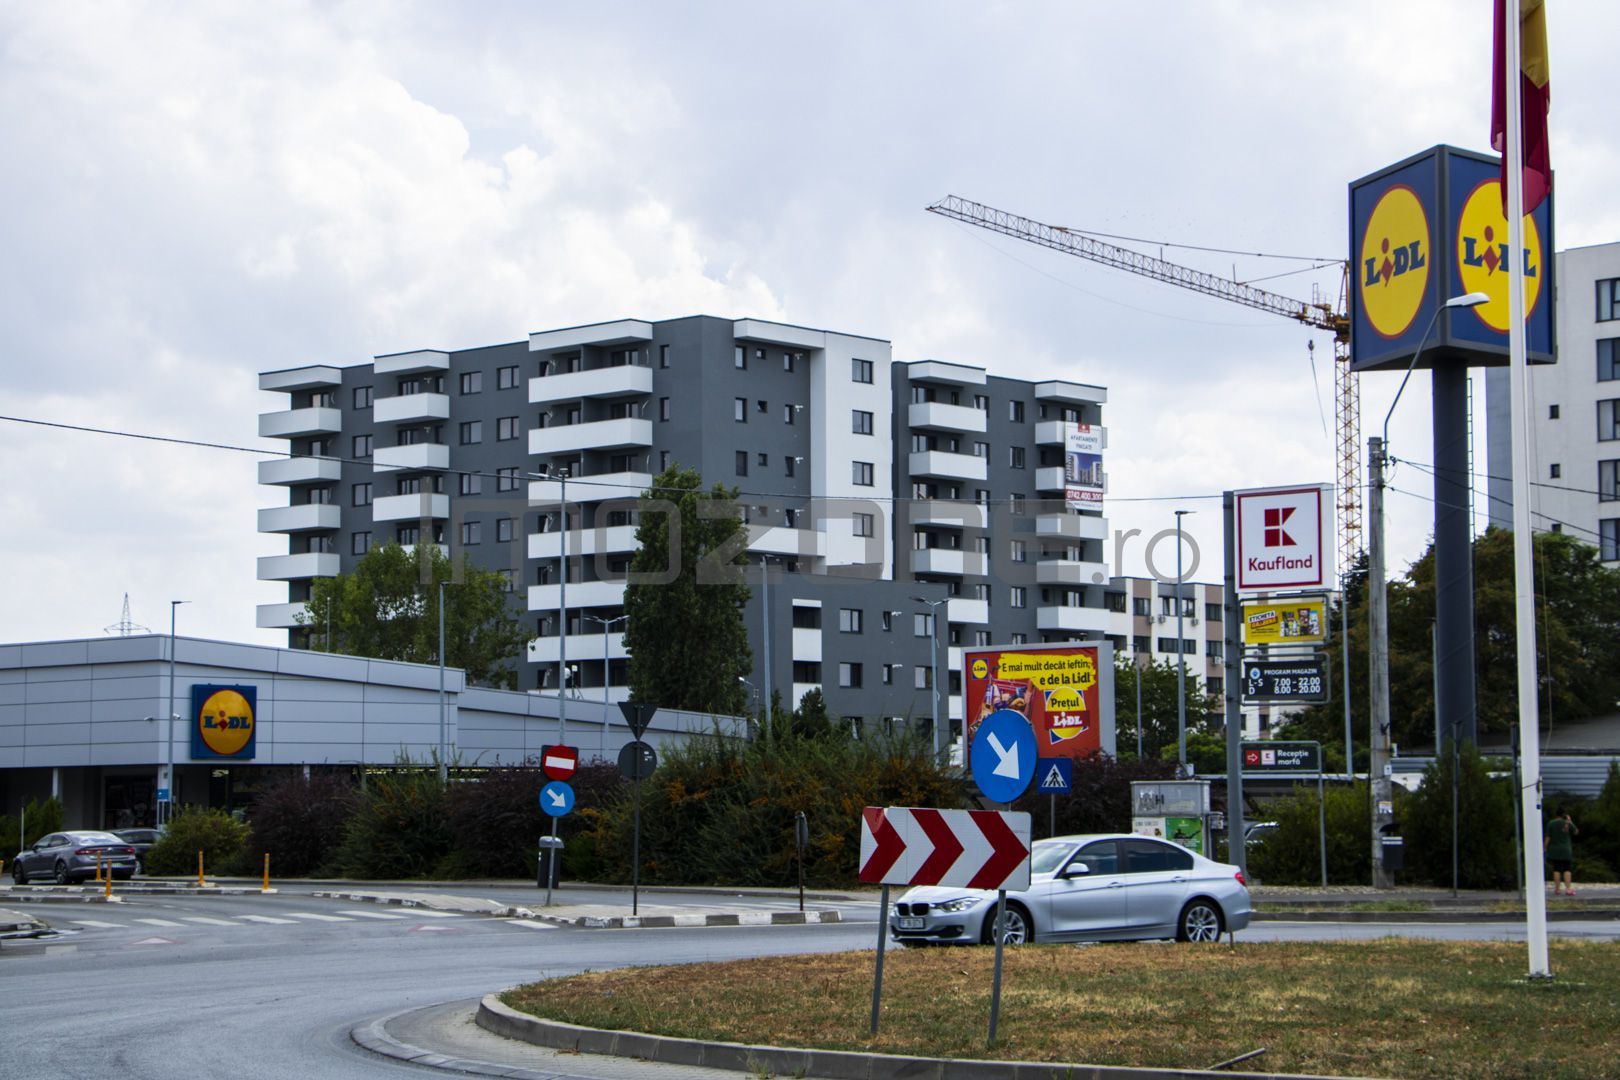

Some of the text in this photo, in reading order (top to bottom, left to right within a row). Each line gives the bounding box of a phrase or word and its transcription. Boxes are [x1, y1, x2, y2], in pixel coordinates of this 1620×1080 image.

[1249, 554, 1313, 571] Kaufland
[1002, 663, 1007, 672] E
[1009, 661, 1022, 671] mai
[1025, 659, 1042, 670] mult
[1043, 659, 1065, 670] decât
[1040, 672, 1090, 685] e de la Lidl
[1249, 687, 1255, 695] D
[1274, 686, 1291, 694] 8.00
[1299, 685, 1320, 693] 20.00
[1277, 750, 1309, 758] Recepție
